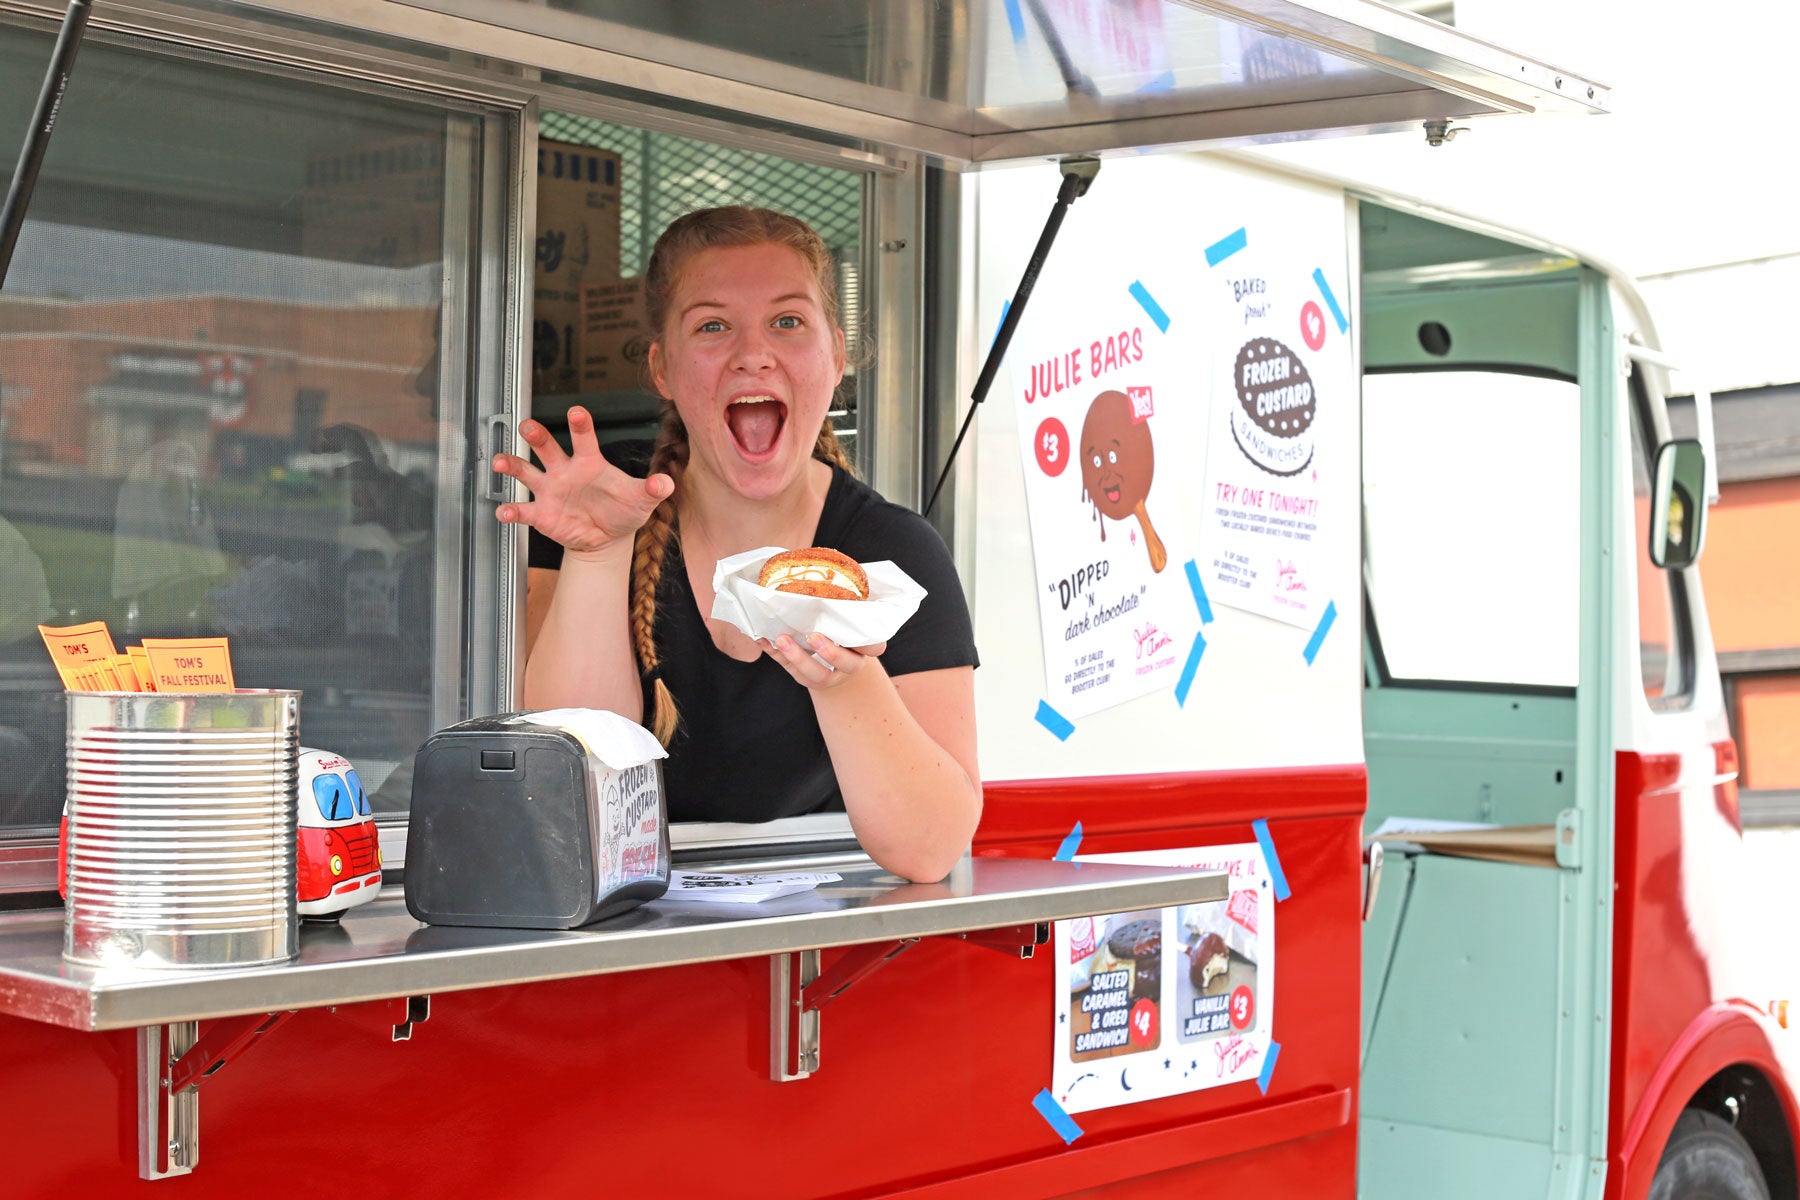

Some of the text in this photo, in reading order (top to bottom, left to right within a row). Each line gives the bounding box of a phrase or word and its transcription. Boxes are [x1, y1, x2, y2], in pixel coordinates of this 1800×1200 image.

[1024, 327, 1143, 404] JULIE BARS
[1242, 356, 1290, 387] FROZEN
[1256, 382, 1312, 417] CUSTARD
[1042, 432, 1059, 462] $3
[1241, 422, 1304, 463] SANDWICHES
[1217, 482, 1319, 518] TRY ONE TONIGHT!
[1049, 560, 1109, 610] "DIPPED
[1065, 585, 1146, 642] dark chocolate"
[62, 643, 89, 656] TOM'S
[174, 657, 204, 669] TOM'S
[161, 674, 227, 686] FALL FESTIVAL
[618, 764, 648, 807] FROZEN
[625, 789, 657, 838] CUSTARD
[641, 814, 657, 835] made
[1092, 972, 1128, 991] SALTED
[1082, 991, 1128, 1012] CARAMEL
[1194, 995, 1230, 1015] VANILLA
[1233, 995, 1248, 1020] $3
[1092, 1011, 1128, 1029] & OREO
[1134, 1011, 1150, 1036] $4
[1185, 1014, 1229, 1035] JULIE BAR
[1076, 1028, 1128, 1051] SANDWICH
